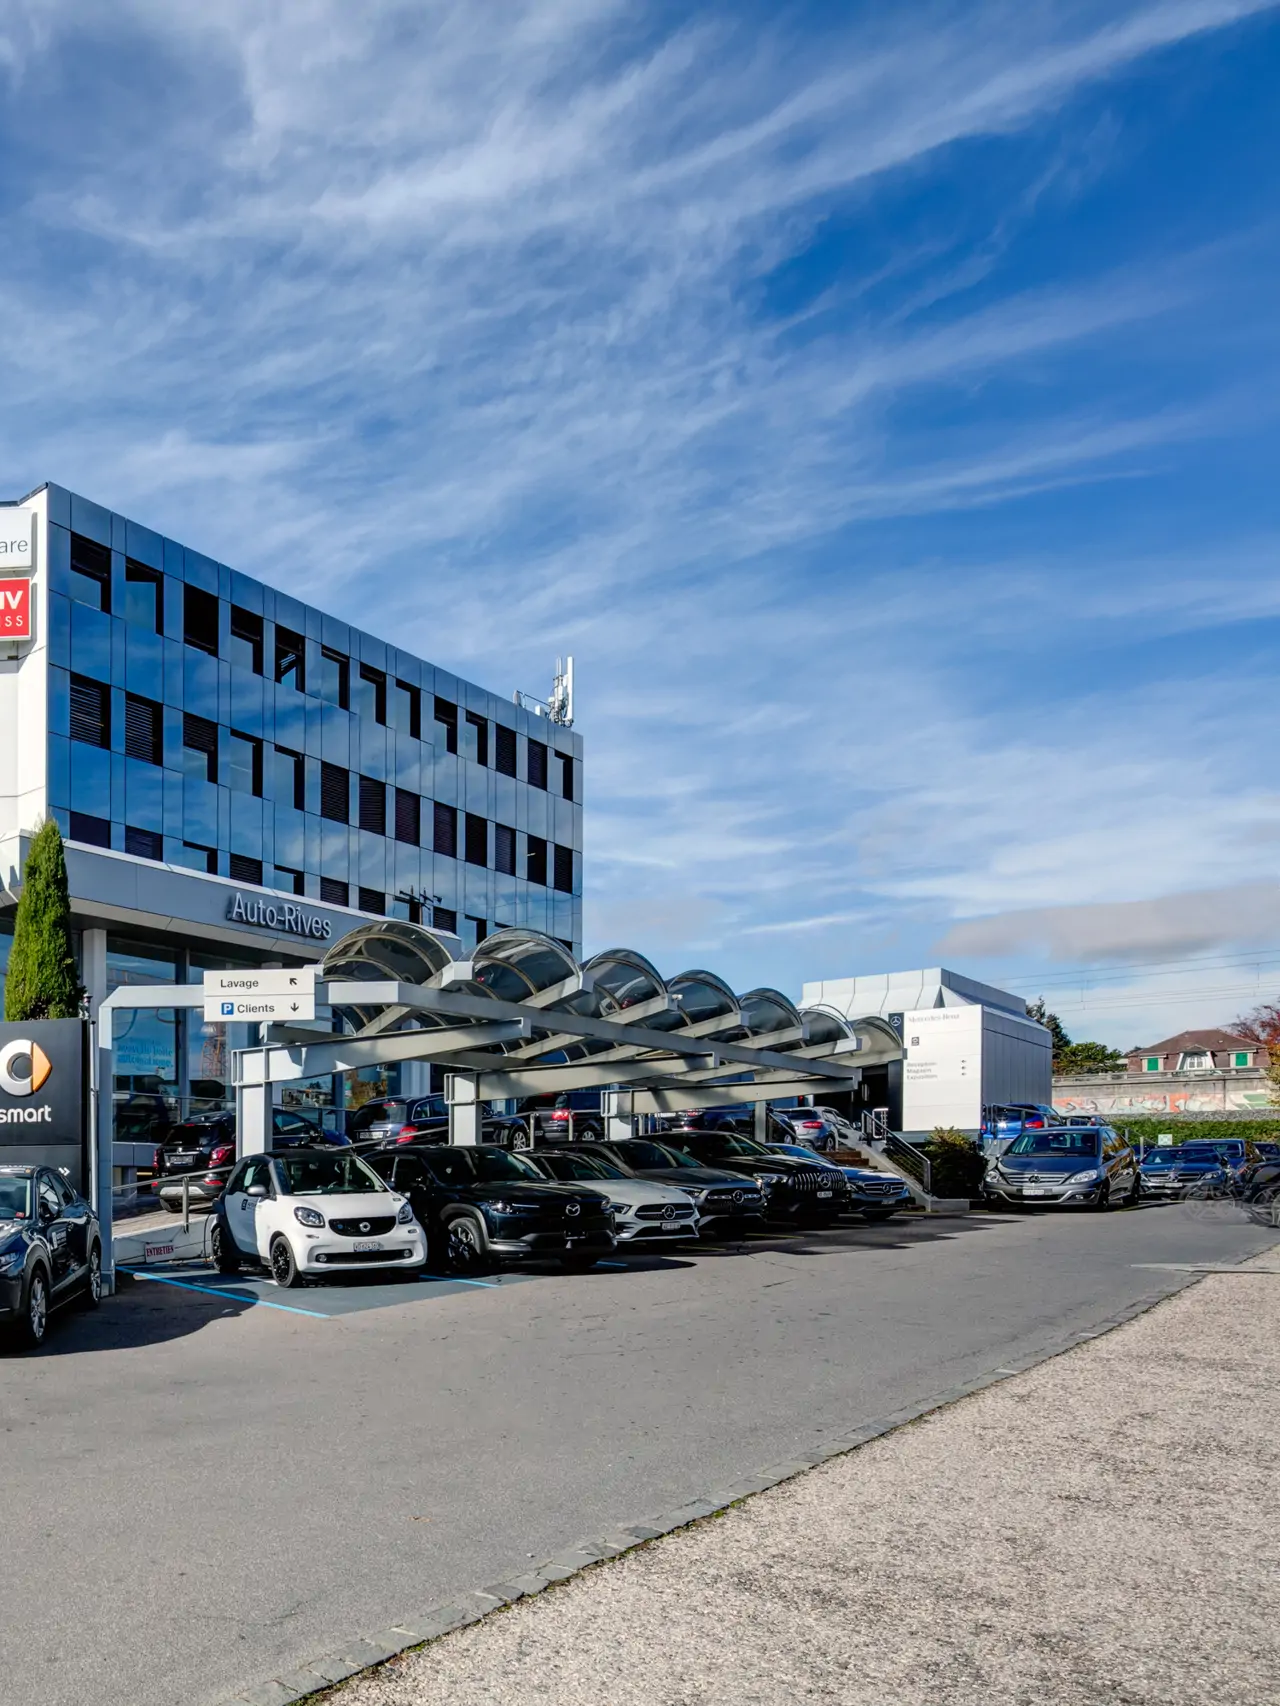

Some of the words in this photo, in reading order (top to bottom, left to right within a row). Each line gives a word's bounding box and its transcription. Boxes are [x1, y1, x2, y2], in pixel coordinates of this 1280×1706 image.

[232, 891, 332, 939] Auto-Rives
[220, 979, 259, 989] Lavage
[237, 1004, 275, 1014] Clients
